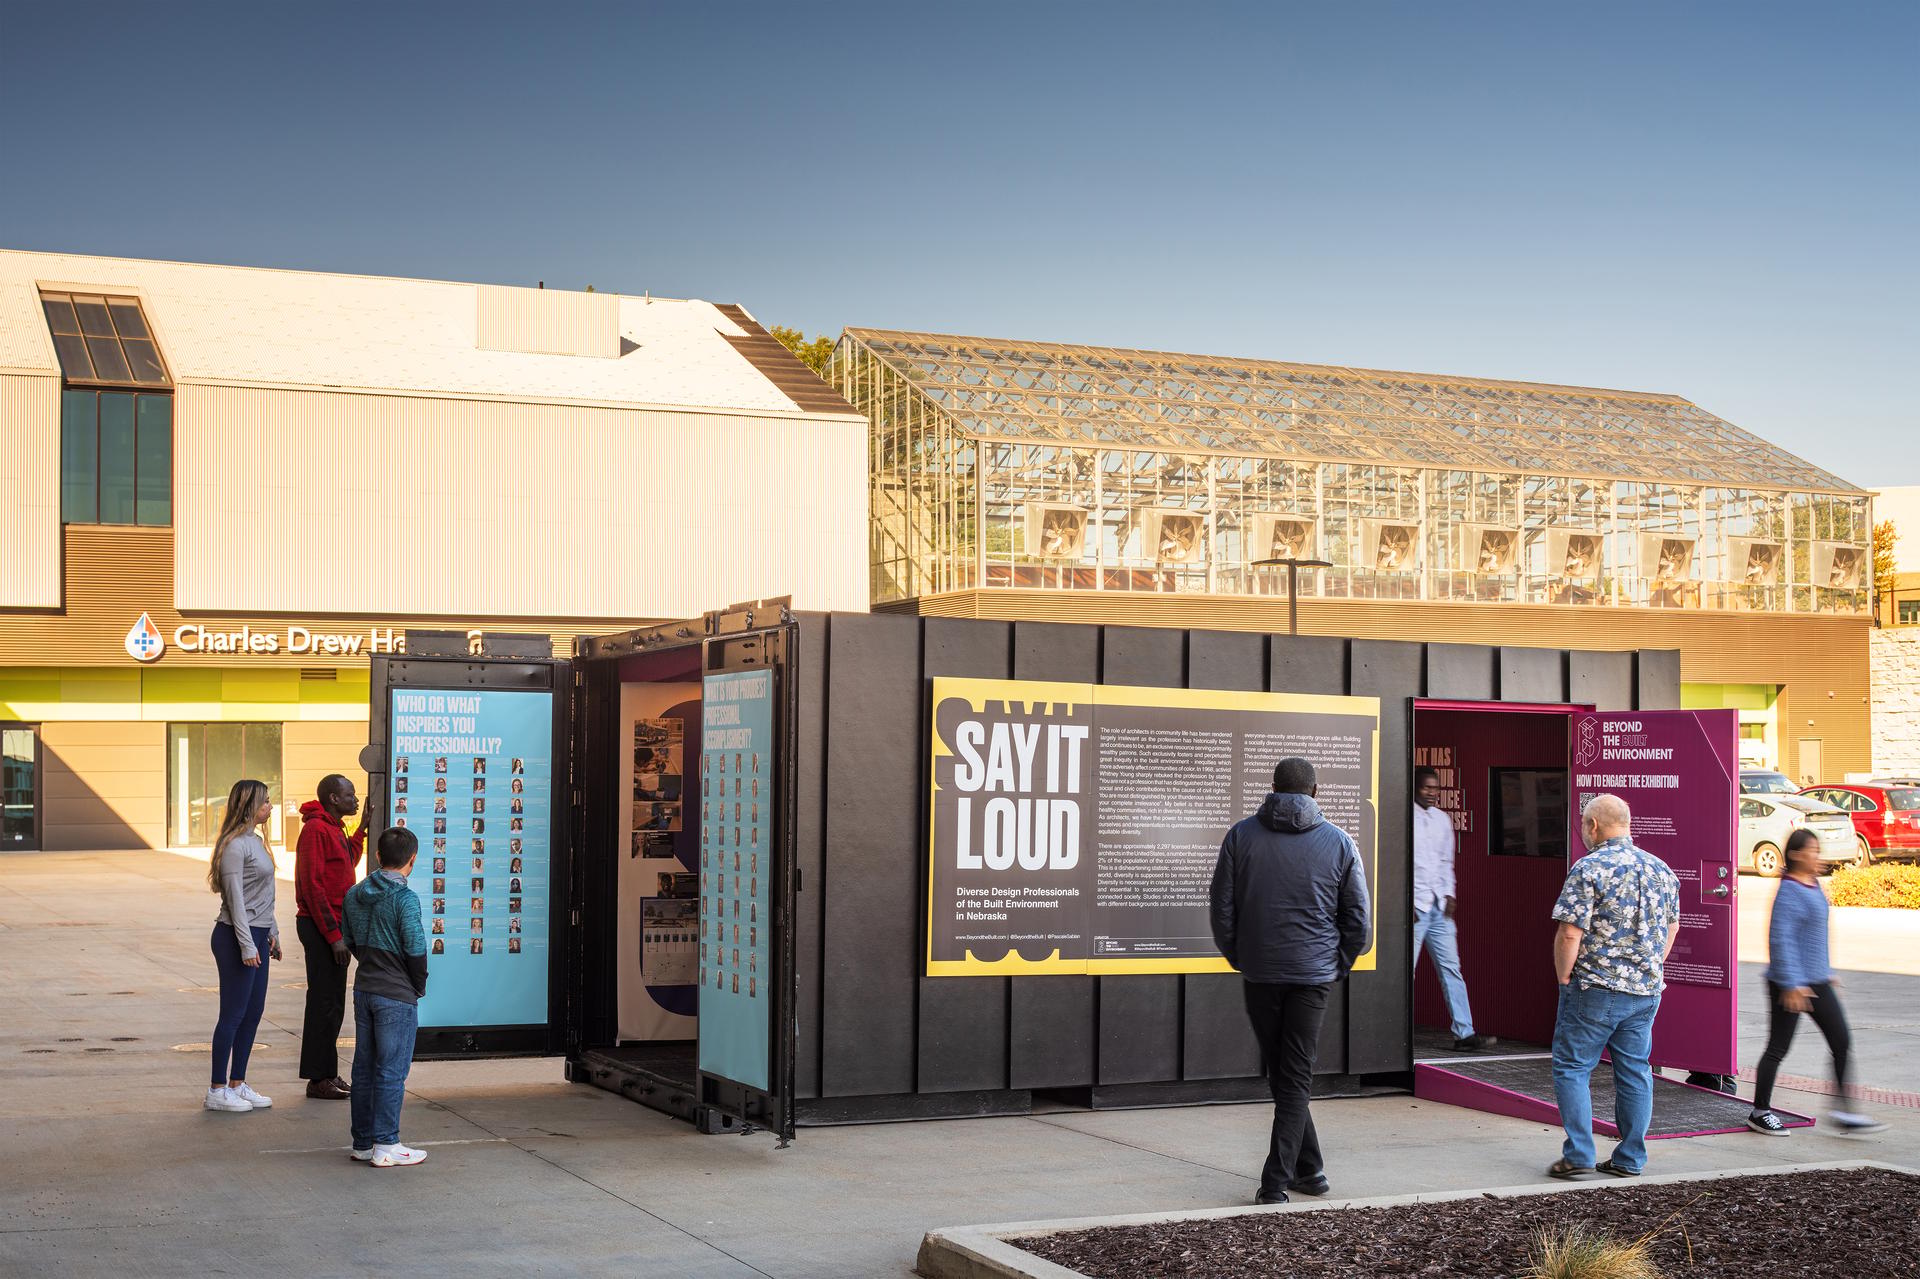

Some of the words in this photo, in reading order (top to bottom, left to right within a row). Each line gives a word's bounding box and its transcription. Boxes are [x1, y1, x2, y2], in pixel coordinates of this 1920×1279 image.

[173, 625, 278, 653] Charles
[287, 627, 363, 653] Drew
[397, 695, 426, 712] WHO
[428, 696, 444, 713] OR
[447, 697, 481, 714] WHAT
[396, 715, 449, 733] INSPIRES
[452, 717, 475, 734] YOU
[705, 704, 740, 726] PROFESSIONAL
[1603, 721, 1642, 732] BEYOND
[396, 735, 502, 754] PROFESSIONALLY?
[1603, 735, 1620, 746] THE
[1622, 735, 1648, 746] BUILT
[954, 721, 1041, 792] SAY
[1047, 725, 1088, 793] IT
[1431, 747, 1451, 766] HAS
[1603, 749, 1673, 760] ENVIRONMENT
[1576, 774, 1591, 787] HOW
[1593, 774, 1601, 787] TO
[1602, 775, 1627, 788] ENGAGE
[1628, 775, 1640, 788] THE
[1641, 775, 1679, 788] EXHIBITION
[957, 797, 1080, 871] LOUD
[957, 888, 989, 896] Diverse
[992, 888, 1020, 897] Design
[1024, 888, 1079, 896] Professionals
[956, 900, 966, 908] of
[967, 900, 981, 908] the
[984, 900, 1003, 908] Built
[1006, 900, 1058, 908] Environment
[956, 912, 964, 920] in
[967, 912, 1007, 920] Nebraska
